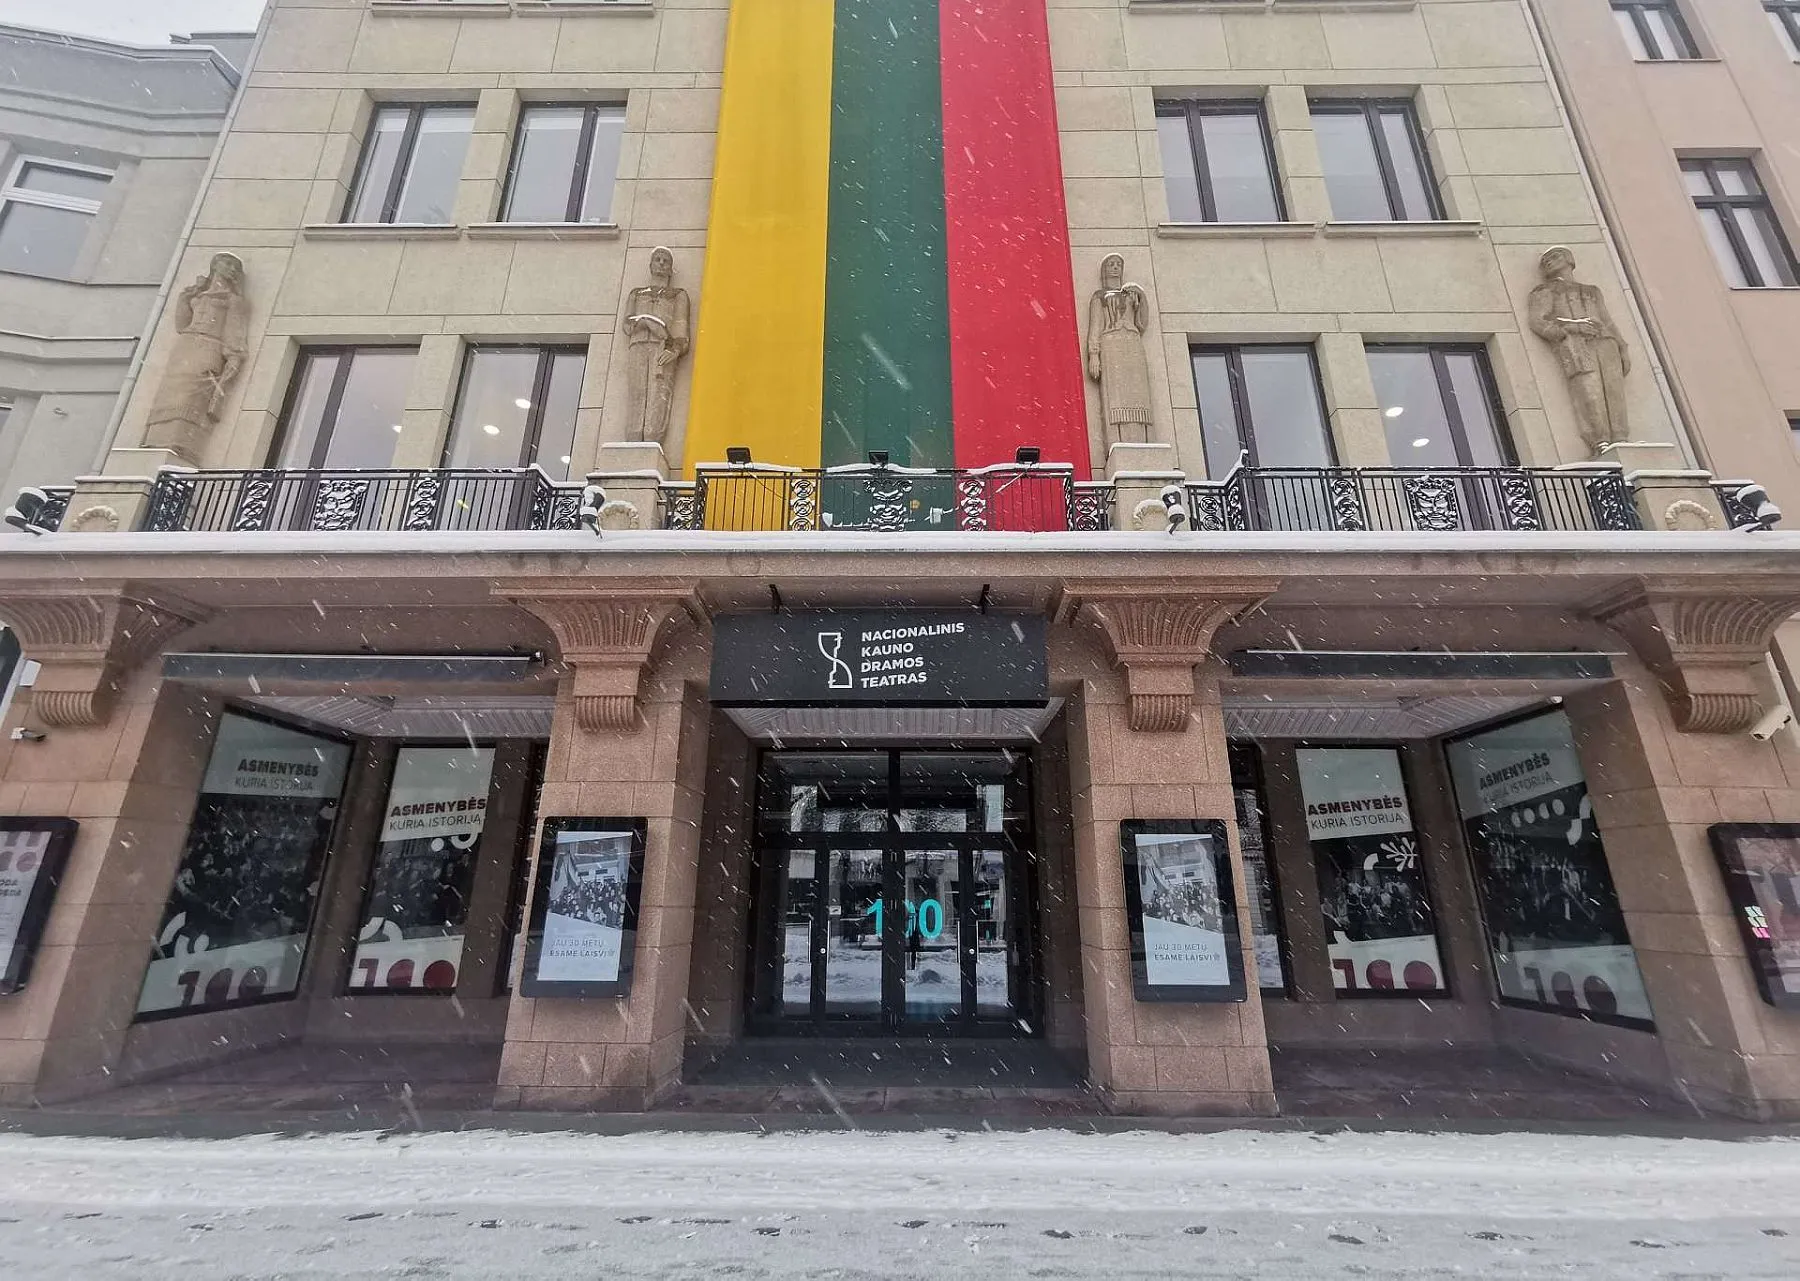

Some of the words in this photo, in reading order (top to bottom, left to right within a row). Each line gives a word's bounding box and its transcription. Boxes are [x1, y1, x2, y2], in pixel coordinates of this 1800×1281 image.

[861, 622, 965, 642] NACIONALINIS
[861, 642, 914, 657] KAUNO
[861, 657, 924, 672] DRAMOS
[860, 672, 927, 688] TEATRAS
[237, 759, 319, 777] ASMENYBĖS
[1480, 752, 1551, 789] ASMENYBĖS
[390, 796, 486, 817] ASMENYBĖS
[1308, 795, 1403, 816] ASMENYBĖS
[390, 818, 425, 831] KURIA
[1311, 817, 1347, 830] KURIA
